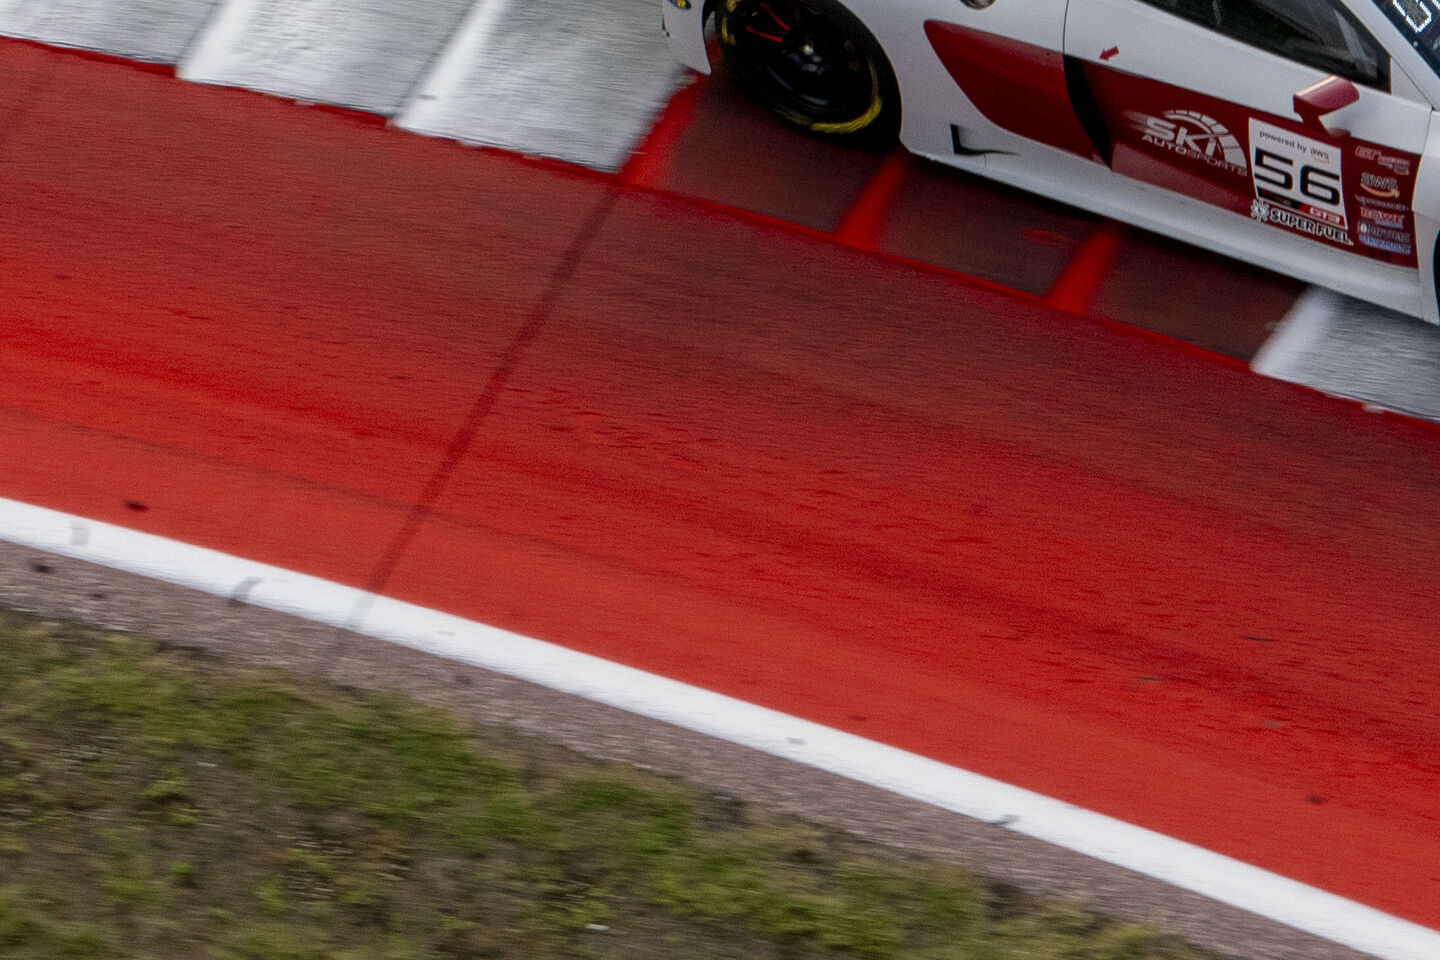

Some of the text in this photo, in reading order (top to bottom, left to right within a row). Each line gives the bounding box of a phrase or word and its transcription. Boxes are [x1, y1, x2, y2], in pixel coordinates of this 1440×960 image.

[1259, 131, 1329, 159] powered by aws
[1254, 147, 1340, 206] 56
